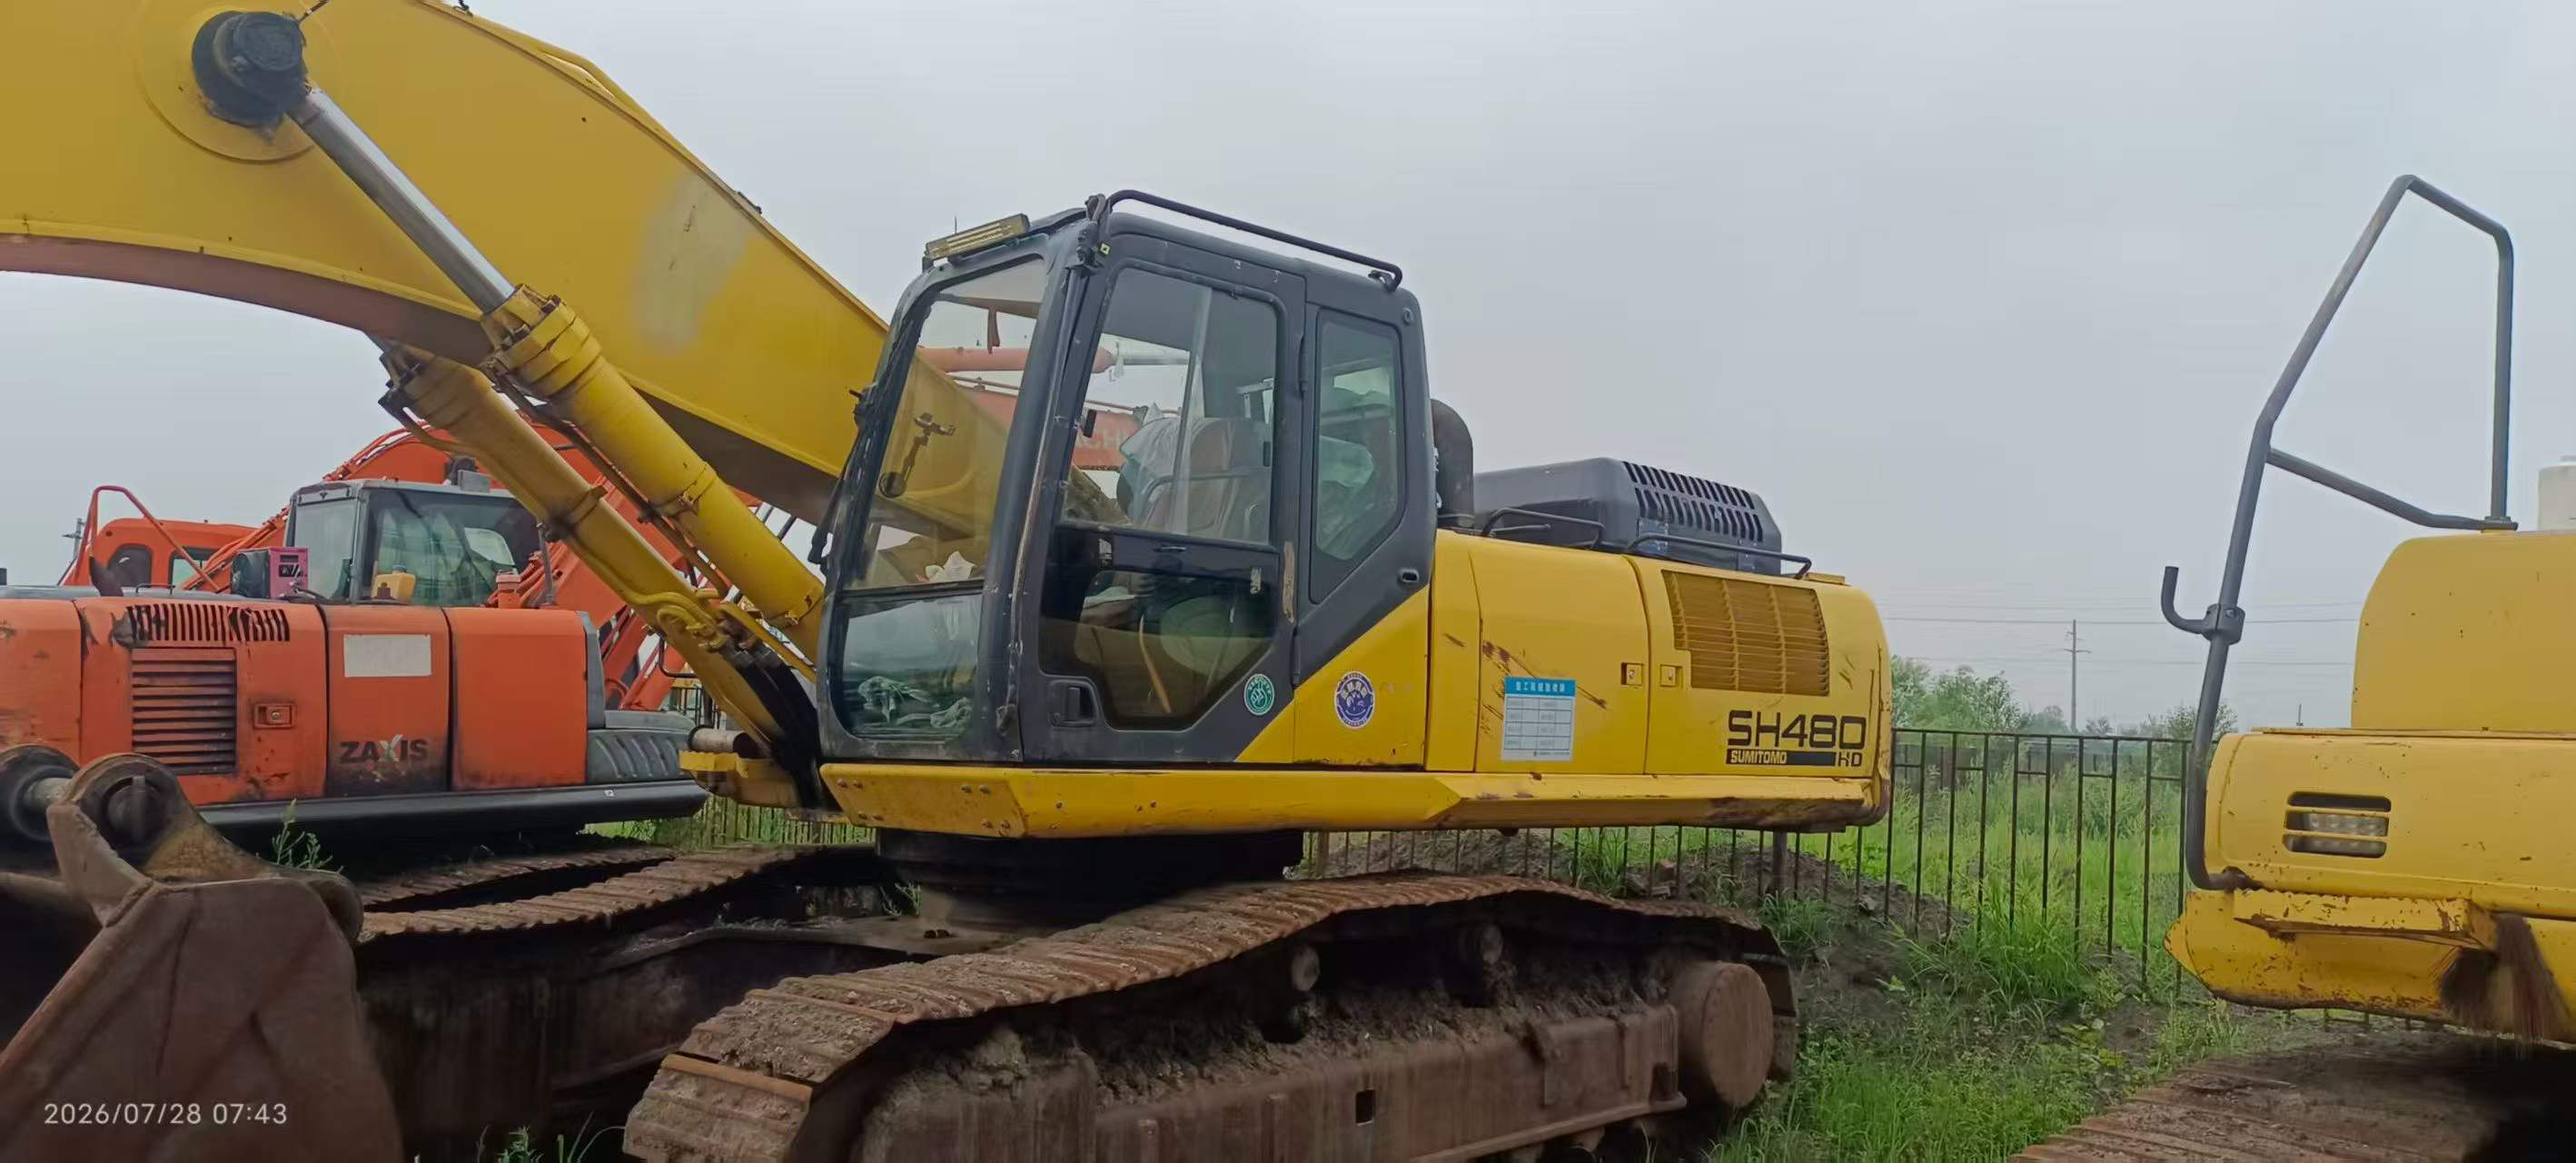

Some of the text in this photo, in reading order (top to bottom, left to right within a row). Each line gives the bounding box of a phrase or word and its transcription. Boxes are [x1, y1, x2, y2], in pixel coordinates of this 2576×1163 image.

[1728, 710, 1867, 750] SH480
[340, 734, 428, 763] ZAXIS
[1730, 750, 1862, 767] SUMITOMO HD
